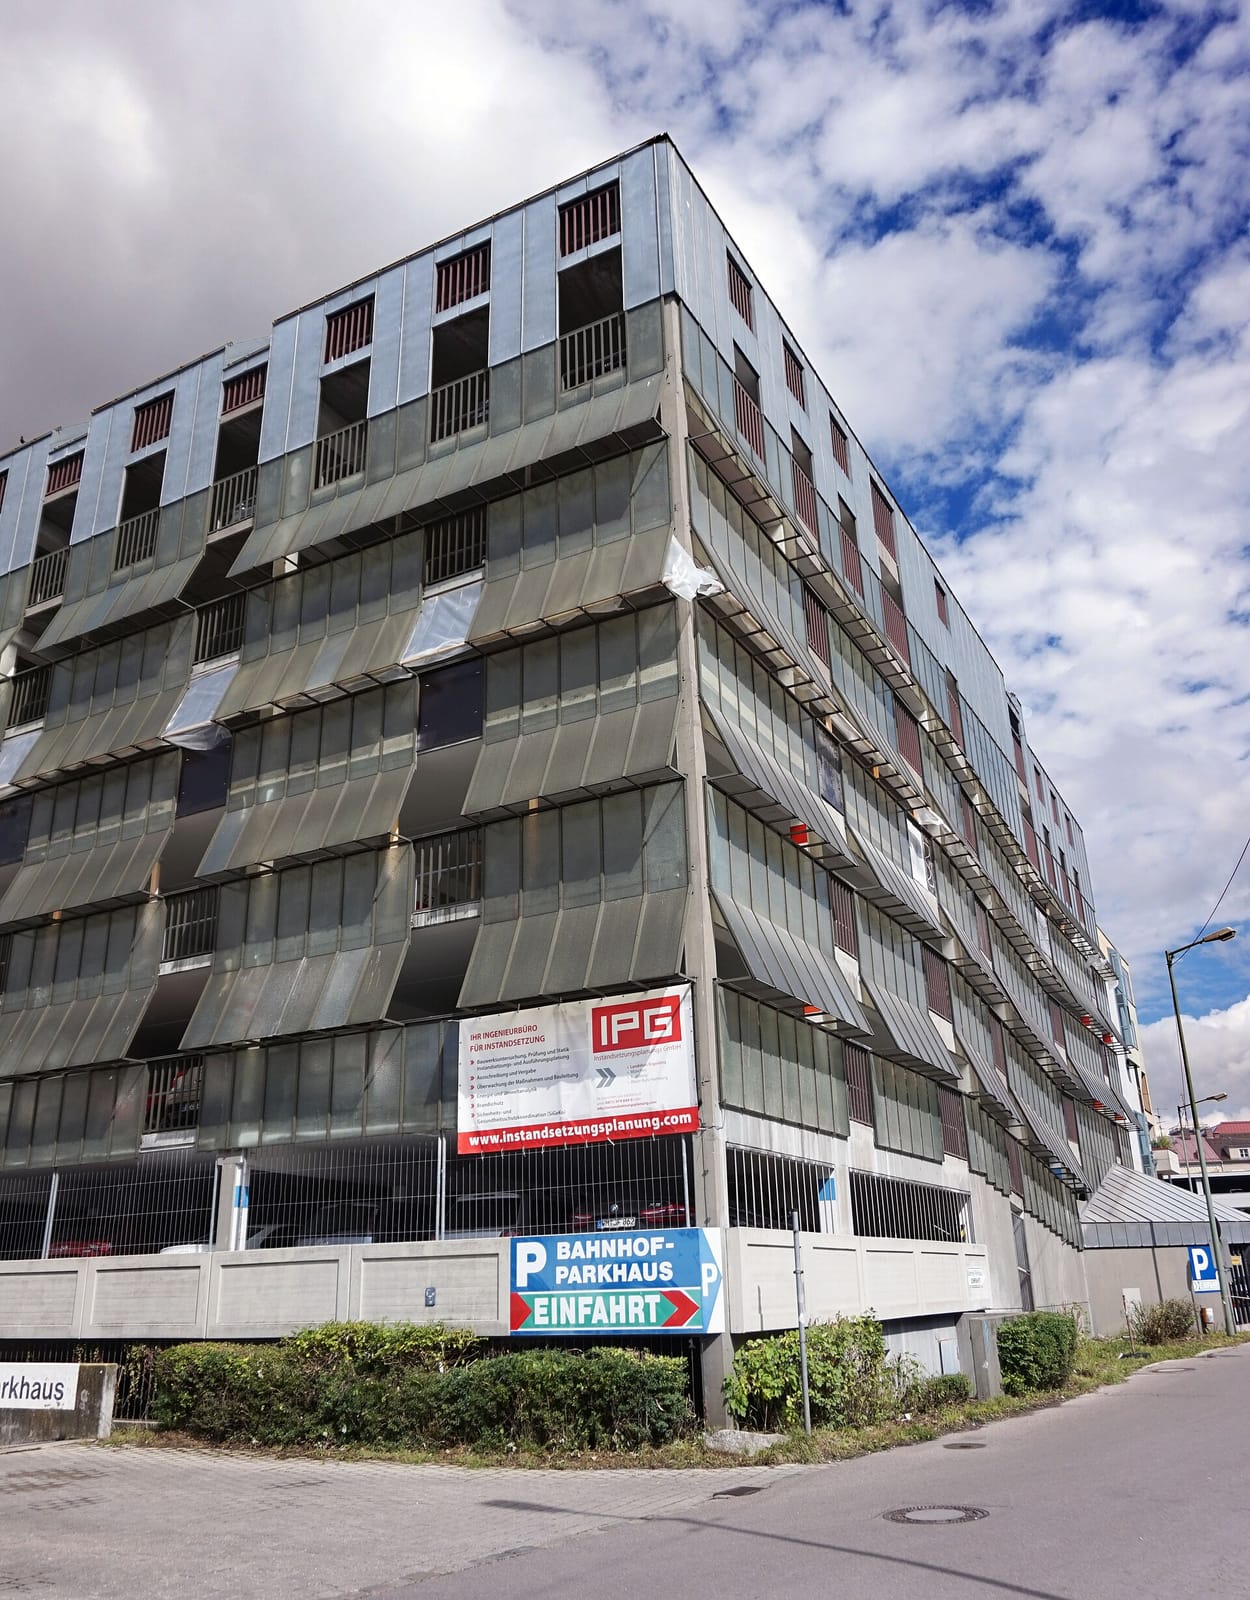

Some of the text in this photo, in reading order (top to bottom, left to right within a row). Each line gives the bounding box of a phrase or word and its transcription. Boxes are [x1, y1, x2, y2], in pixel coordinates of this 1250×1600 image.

[470, 1024, 538, 1041] IHR INGENIEURBÜRO
[600, 1005, 673, 1045] IPG
[470, 1035, 545, 1052] FÜR INSTANDSETZUNG
[518, 1068, 536, 1076] Vergabe
[468, 1112, 692, 1146] www.instandsetzungsplanung.com
[556, 1237, 675, 1260] BAHNHOF-
[516, 1242, 547, 1288] P
[555, 1262, 673, 1285] PARKHAUS
[1191, 1248, 1209, 1280] P
[701, 1263, 718, 1297] P
[533, 1295, 661, 1325] EINFAHRT
[0, 1375, 65, 1400] rkhaus
